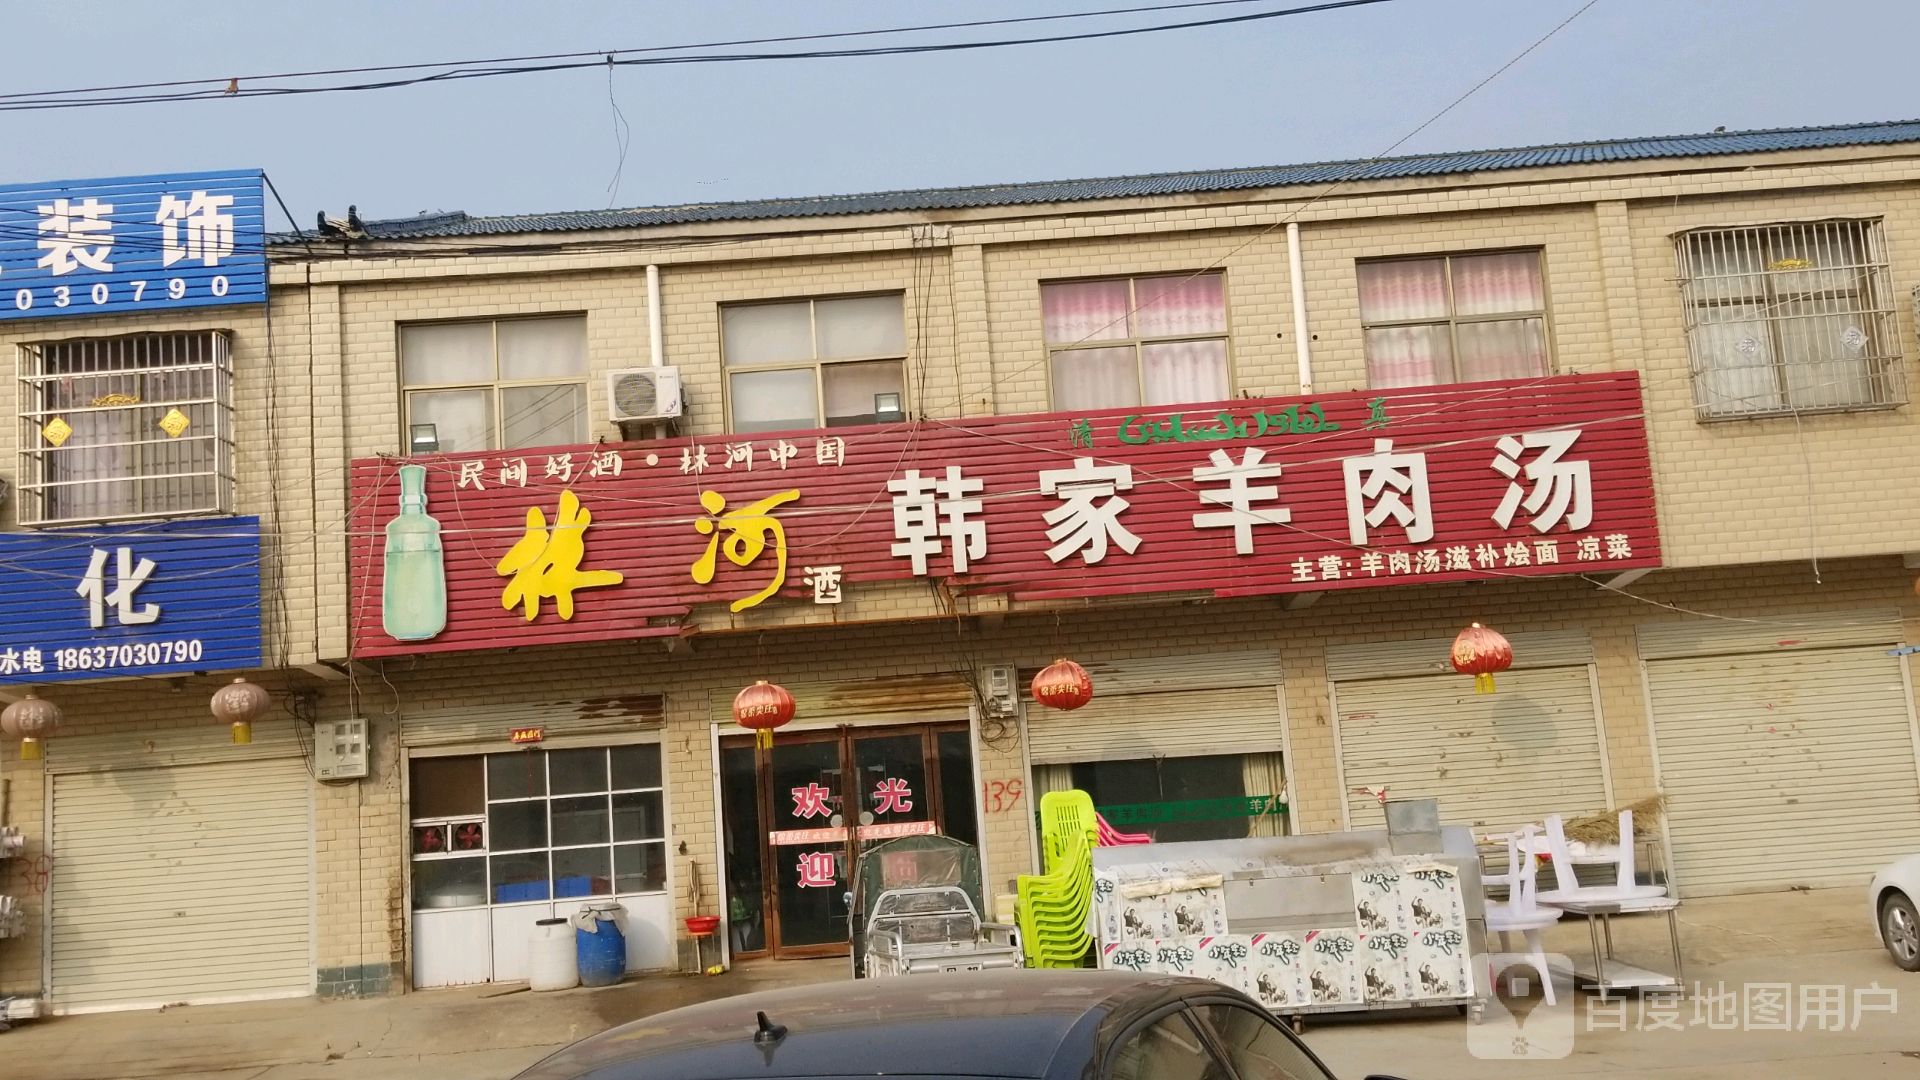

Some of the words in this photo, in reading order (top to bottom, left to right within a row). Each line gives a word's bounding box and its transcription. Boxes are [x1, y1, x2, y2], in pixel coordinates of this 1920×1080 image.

[37, 191, 234, 276] 装饰
[15, 275, 230, 311] 030790
[887, 429, 1593, 576] 韩家羊肉汤
[1576, 533, 1632, 561] 凉菜
[76, 547, 160, 628] 化
[803, 565, 842, 604] 酒
[0, 647, 44, 674] 水电
[54, 639, 202, 671] 18637030790
[983, 779, 1023, 815] 139
